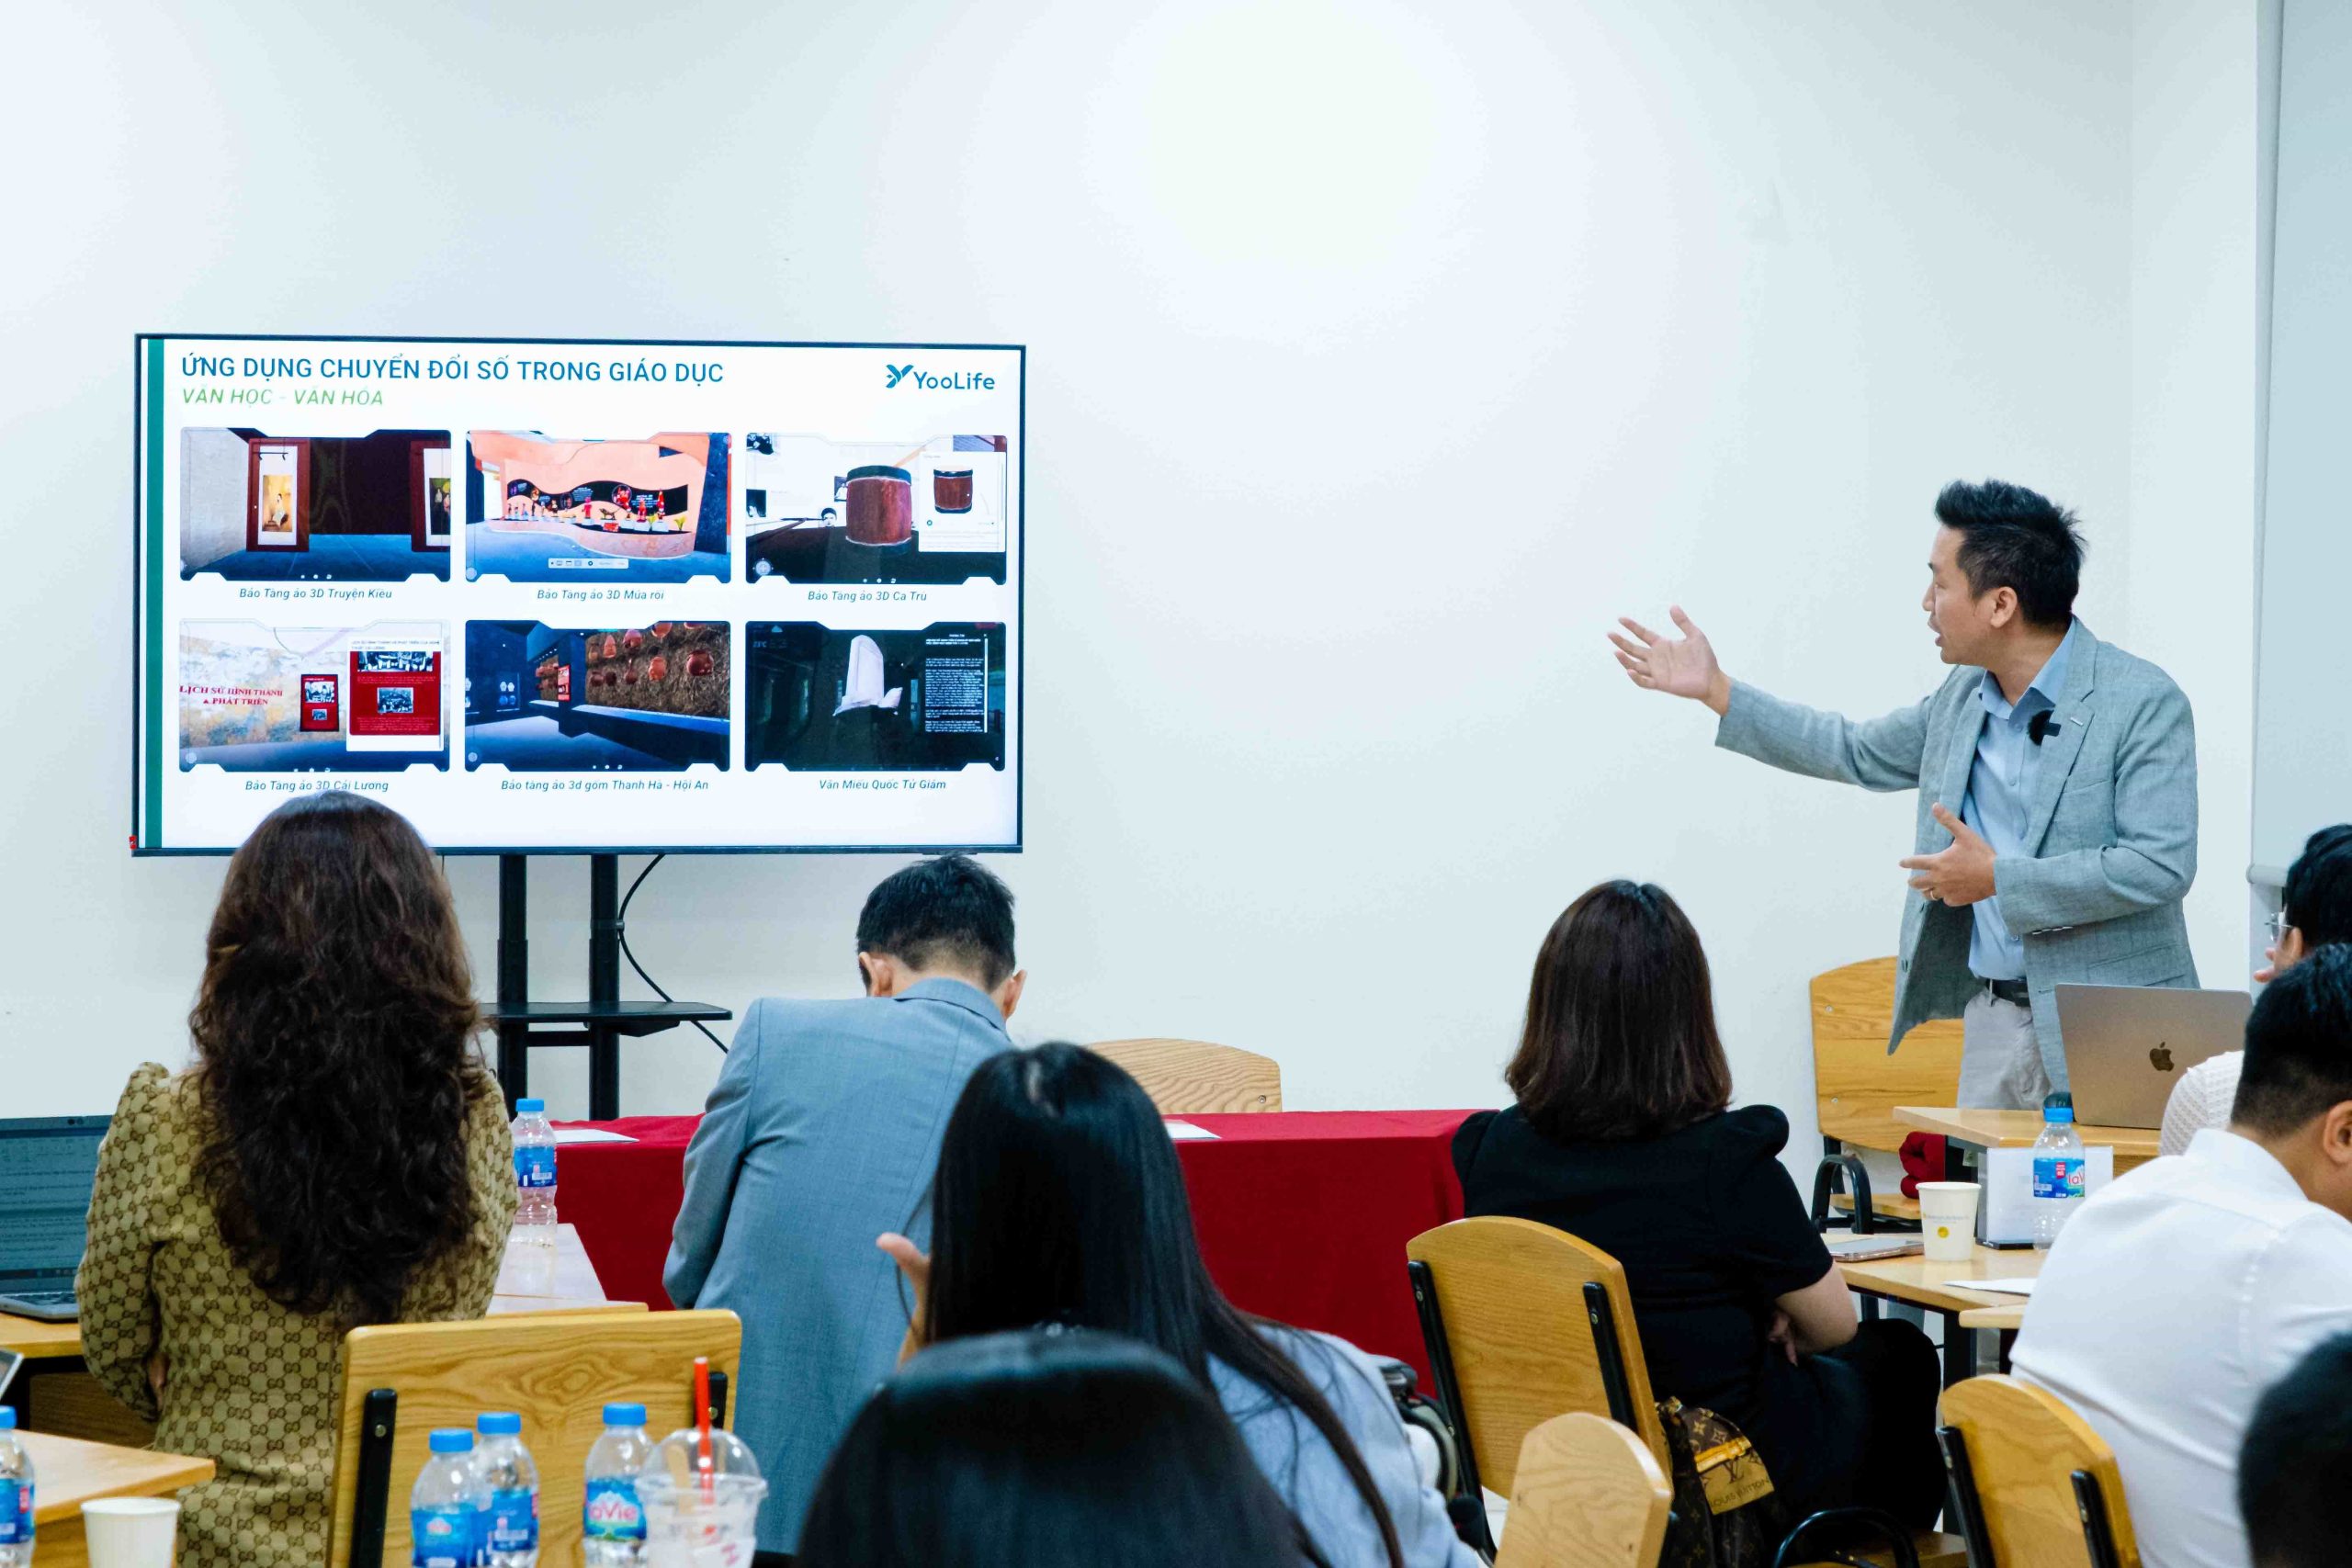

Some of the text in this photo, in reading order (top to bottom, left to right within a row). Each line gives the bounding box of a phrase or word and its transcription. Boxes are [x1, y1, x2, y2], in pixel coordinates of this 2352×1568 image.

[182, 353, 724, 387] ỨNG DỤNG CHUYỂN ĐỔI SỐ TRONG GIÁO DỤC
[913, 371, 995, 390] YooLife
[230, 388, 273, 408] HỌC
[310, 588, 324, 598] 3D
[606, 589, 621, 600] 3D
[876, 591, 889, 601] 3D
[893, 591, 907, 601] Ca
[316, 781, 331, 790] 3D
[569, 780, 582, 790] 3d
[612, 780, 645, 790] Thanh
[694, 780, 709, 790] An
